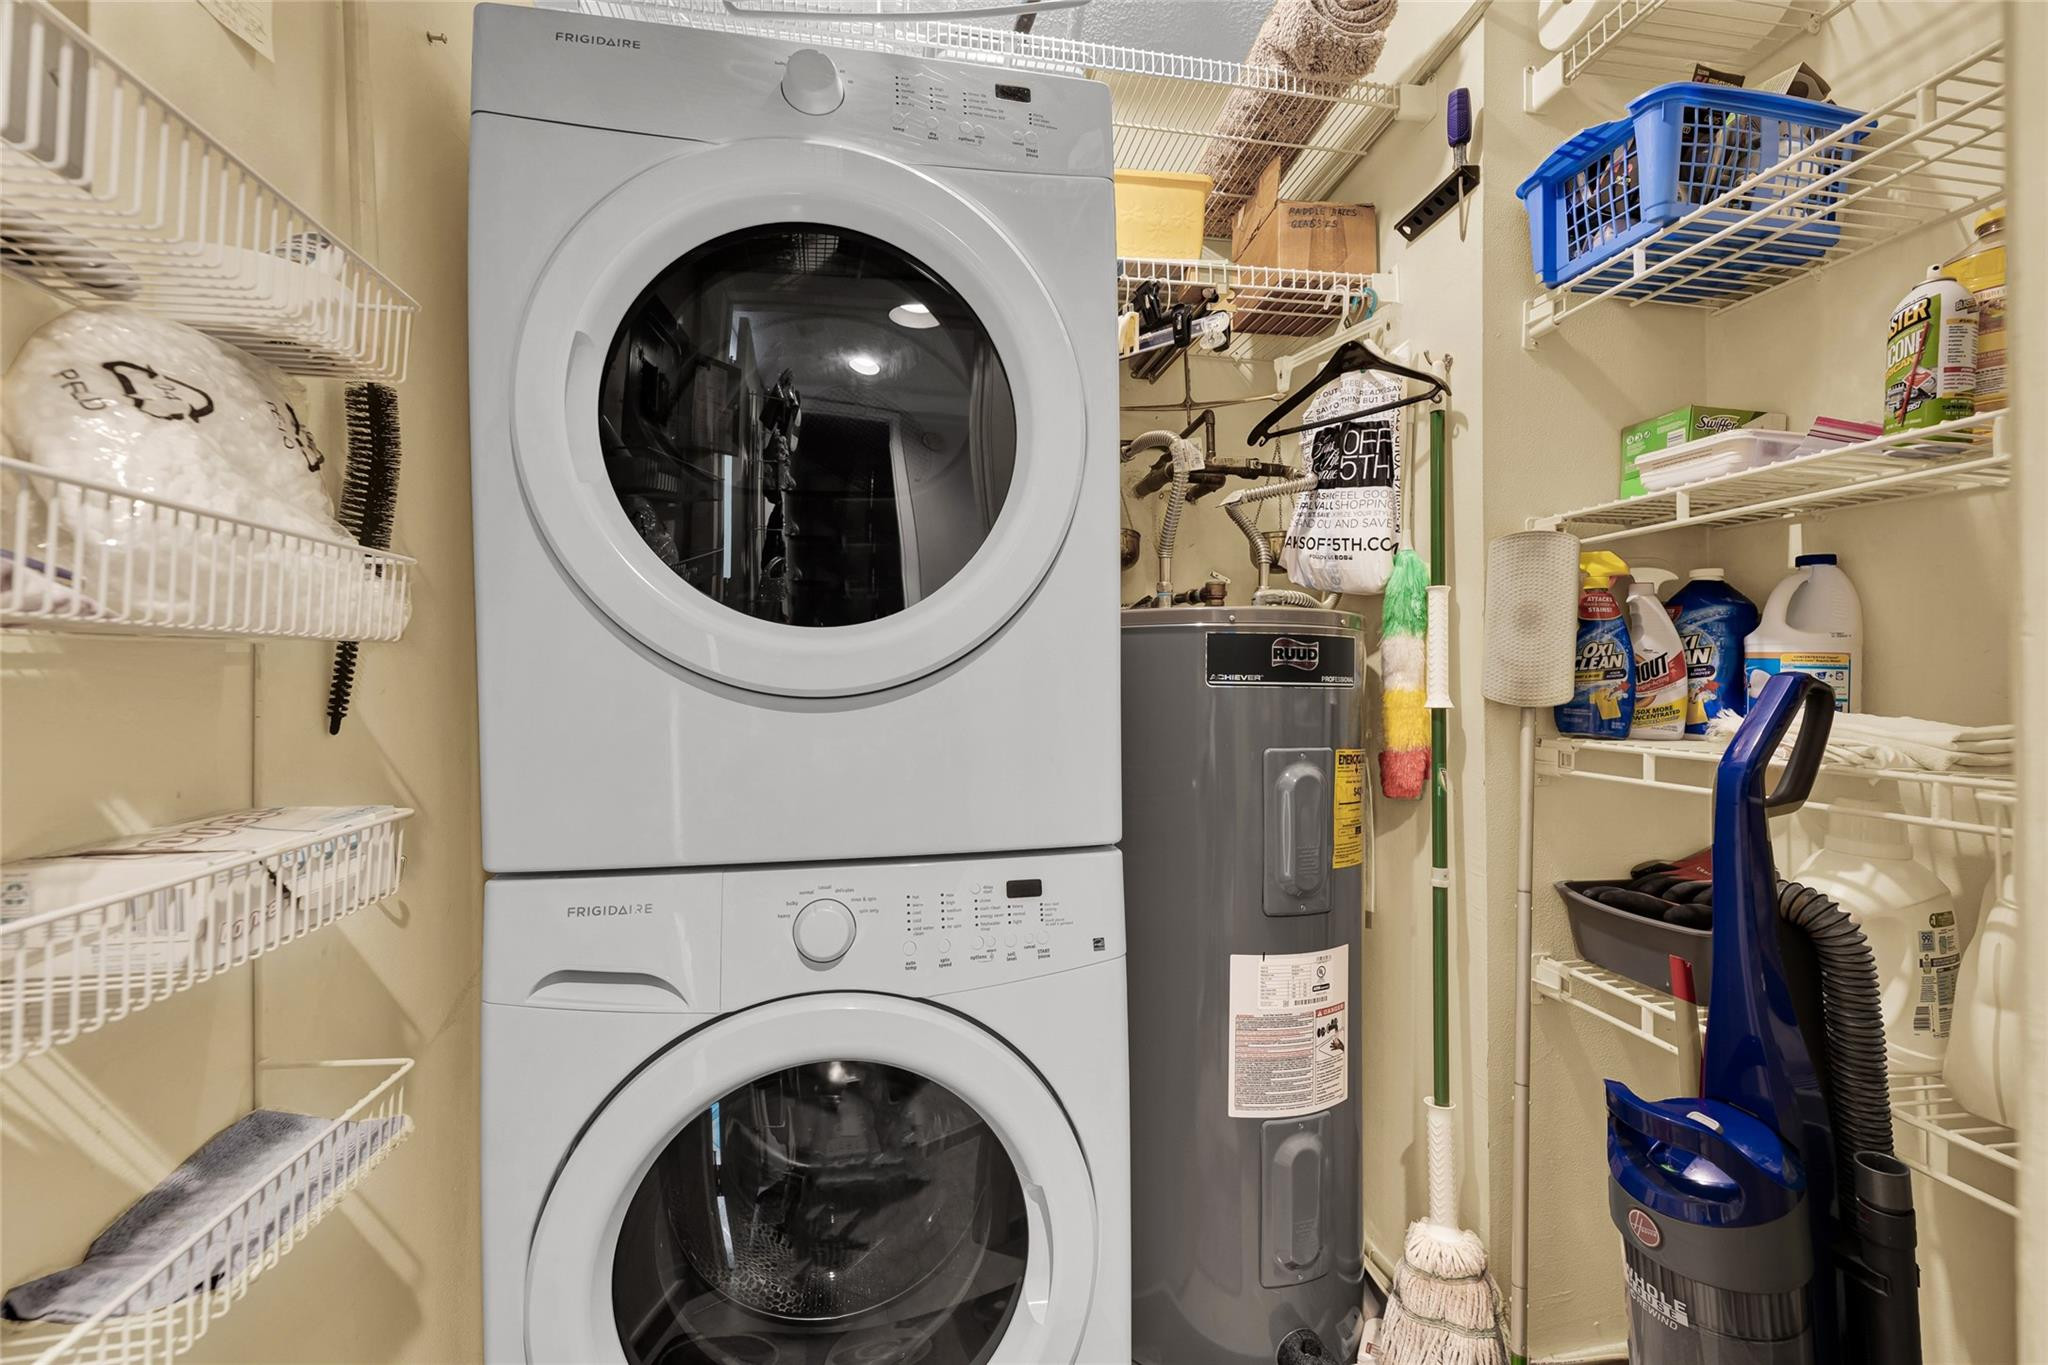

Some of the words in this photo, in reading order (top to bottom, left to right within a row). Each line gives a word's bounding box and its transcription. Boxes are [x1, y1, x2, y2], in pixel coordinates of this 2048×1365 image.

[555, 31, 641, 50] FRIGIDAIRE
[1695, 414, 1737, 432] Swiffer
[1343, 427, 1391, 455] OFF
[1340, 453, 1390, 480] 5TH
[1273, 648, 1318, 661] RUUD
[1583, 642, 1614, 657] OXI
[567, 903, 653, 917] FRIGIDAIRE
